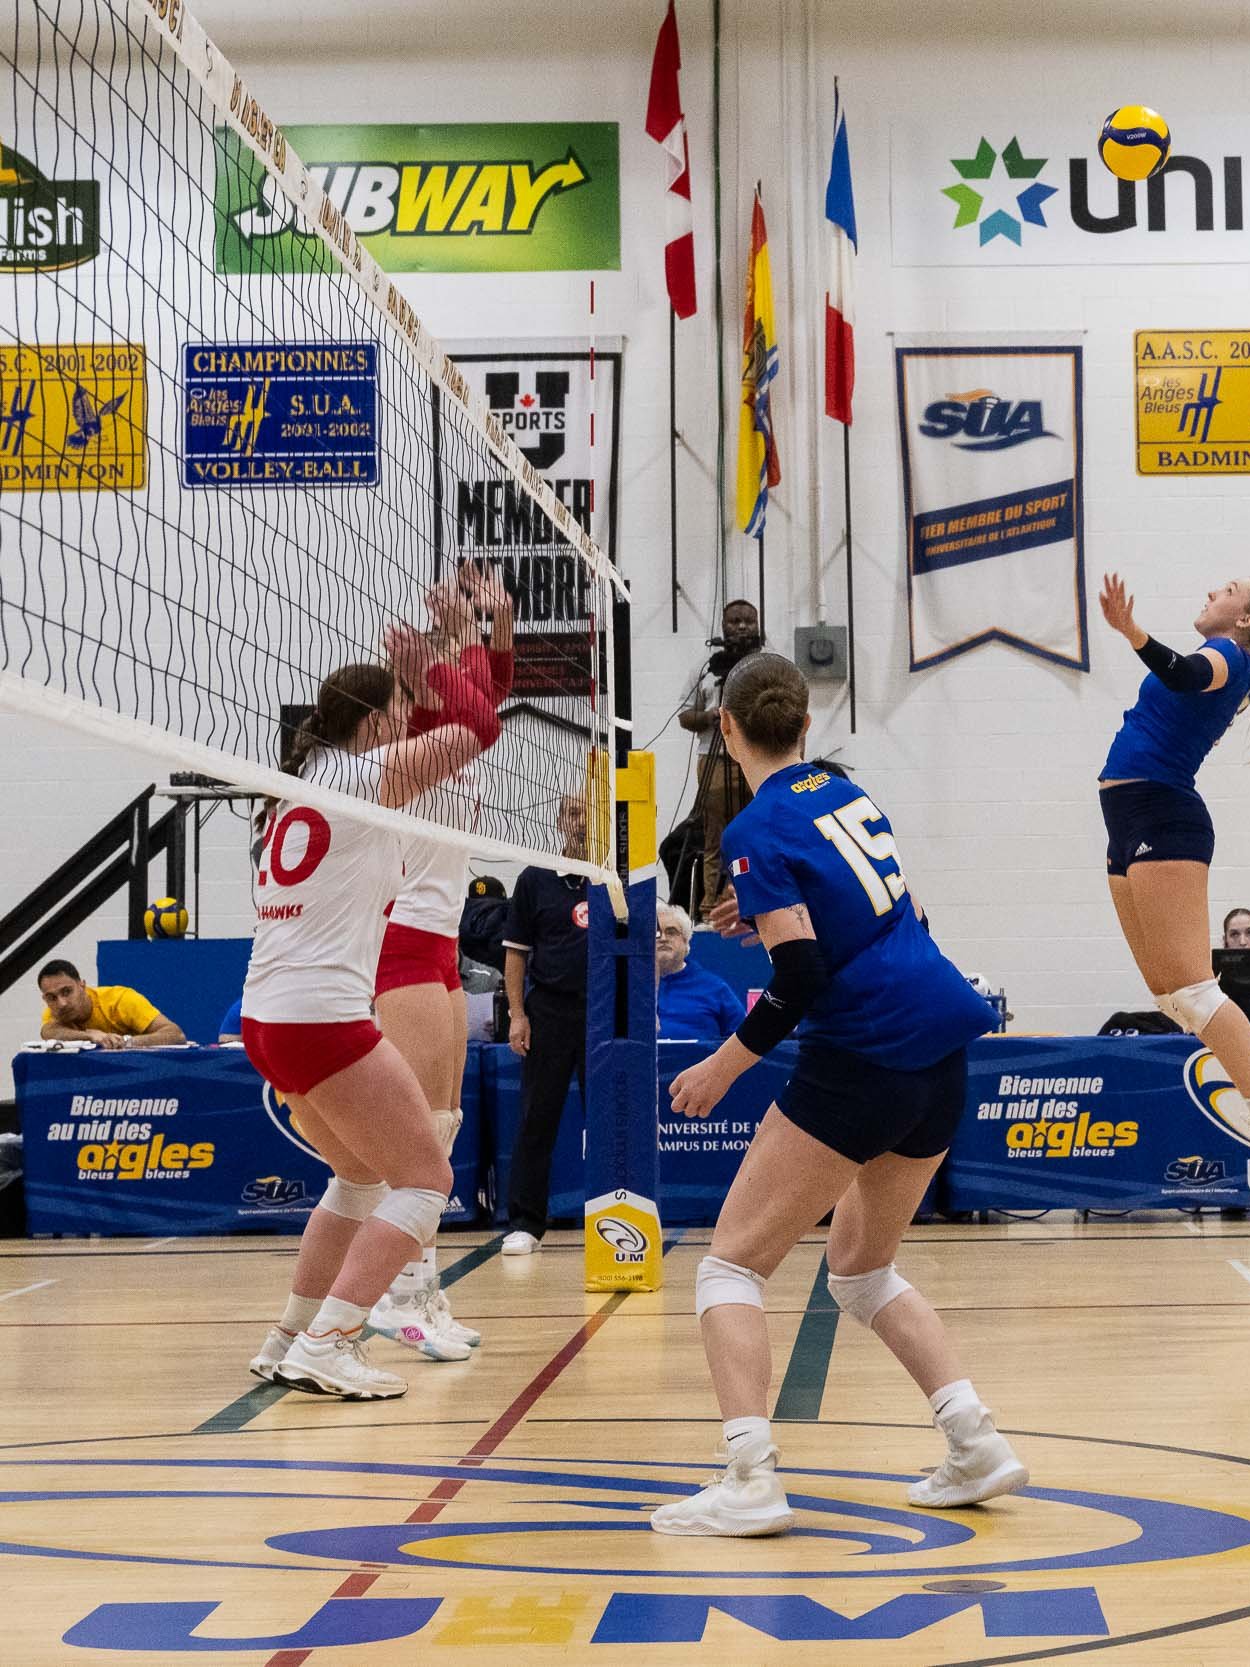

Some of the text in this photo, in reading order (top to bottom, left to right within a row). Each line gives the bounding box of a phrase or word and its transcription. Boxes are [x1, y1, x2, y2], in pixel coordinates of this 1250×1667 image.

[233, 157, 588, 241] SUBWAY
[1069, 155, 1244, 234] uni
[1141, 339, 1218, 361] A.A.S.C.
[193, 350, 368, 373] CHAMPIONNES
[1140, 386, 1194, 402] Anges
[919, 400, 1043, 439] SUA
[1144, 402, 1181, 415] Bleus
[195, 460, 368, 480] VOLLEY-BALL
[947, 509, 1002, 535] MEMBRE
[1004, 503, 1022, 521] DU
[1025, 492, 1068, 517] SPORT
[813, 796, 906, 917] 15
[257, 903, 303, 920] HAWKS
[998, 1075, 1103, 1096] Bienvenue
[70, 1095, 179, 1117] Bienvenue
[977, 1098, 1079, 1120] au nid des
[48, 1120, 152, 1141] au nid des
[658, 1119, 728, 1135] NIVERSITÉ
[732, 1122, 751, 1134] DE
[1006, 1111, 1140, 1158] aigles
[77, 1133, 215, 1180] aigles
[657, 1141, 700, 1152] AMPUS
[703, 1141, 720, 1152] DE
[1007, 1146, 1116, 1159] bleus bleues
[78, 1168, 190, 1181] bleus bleues
